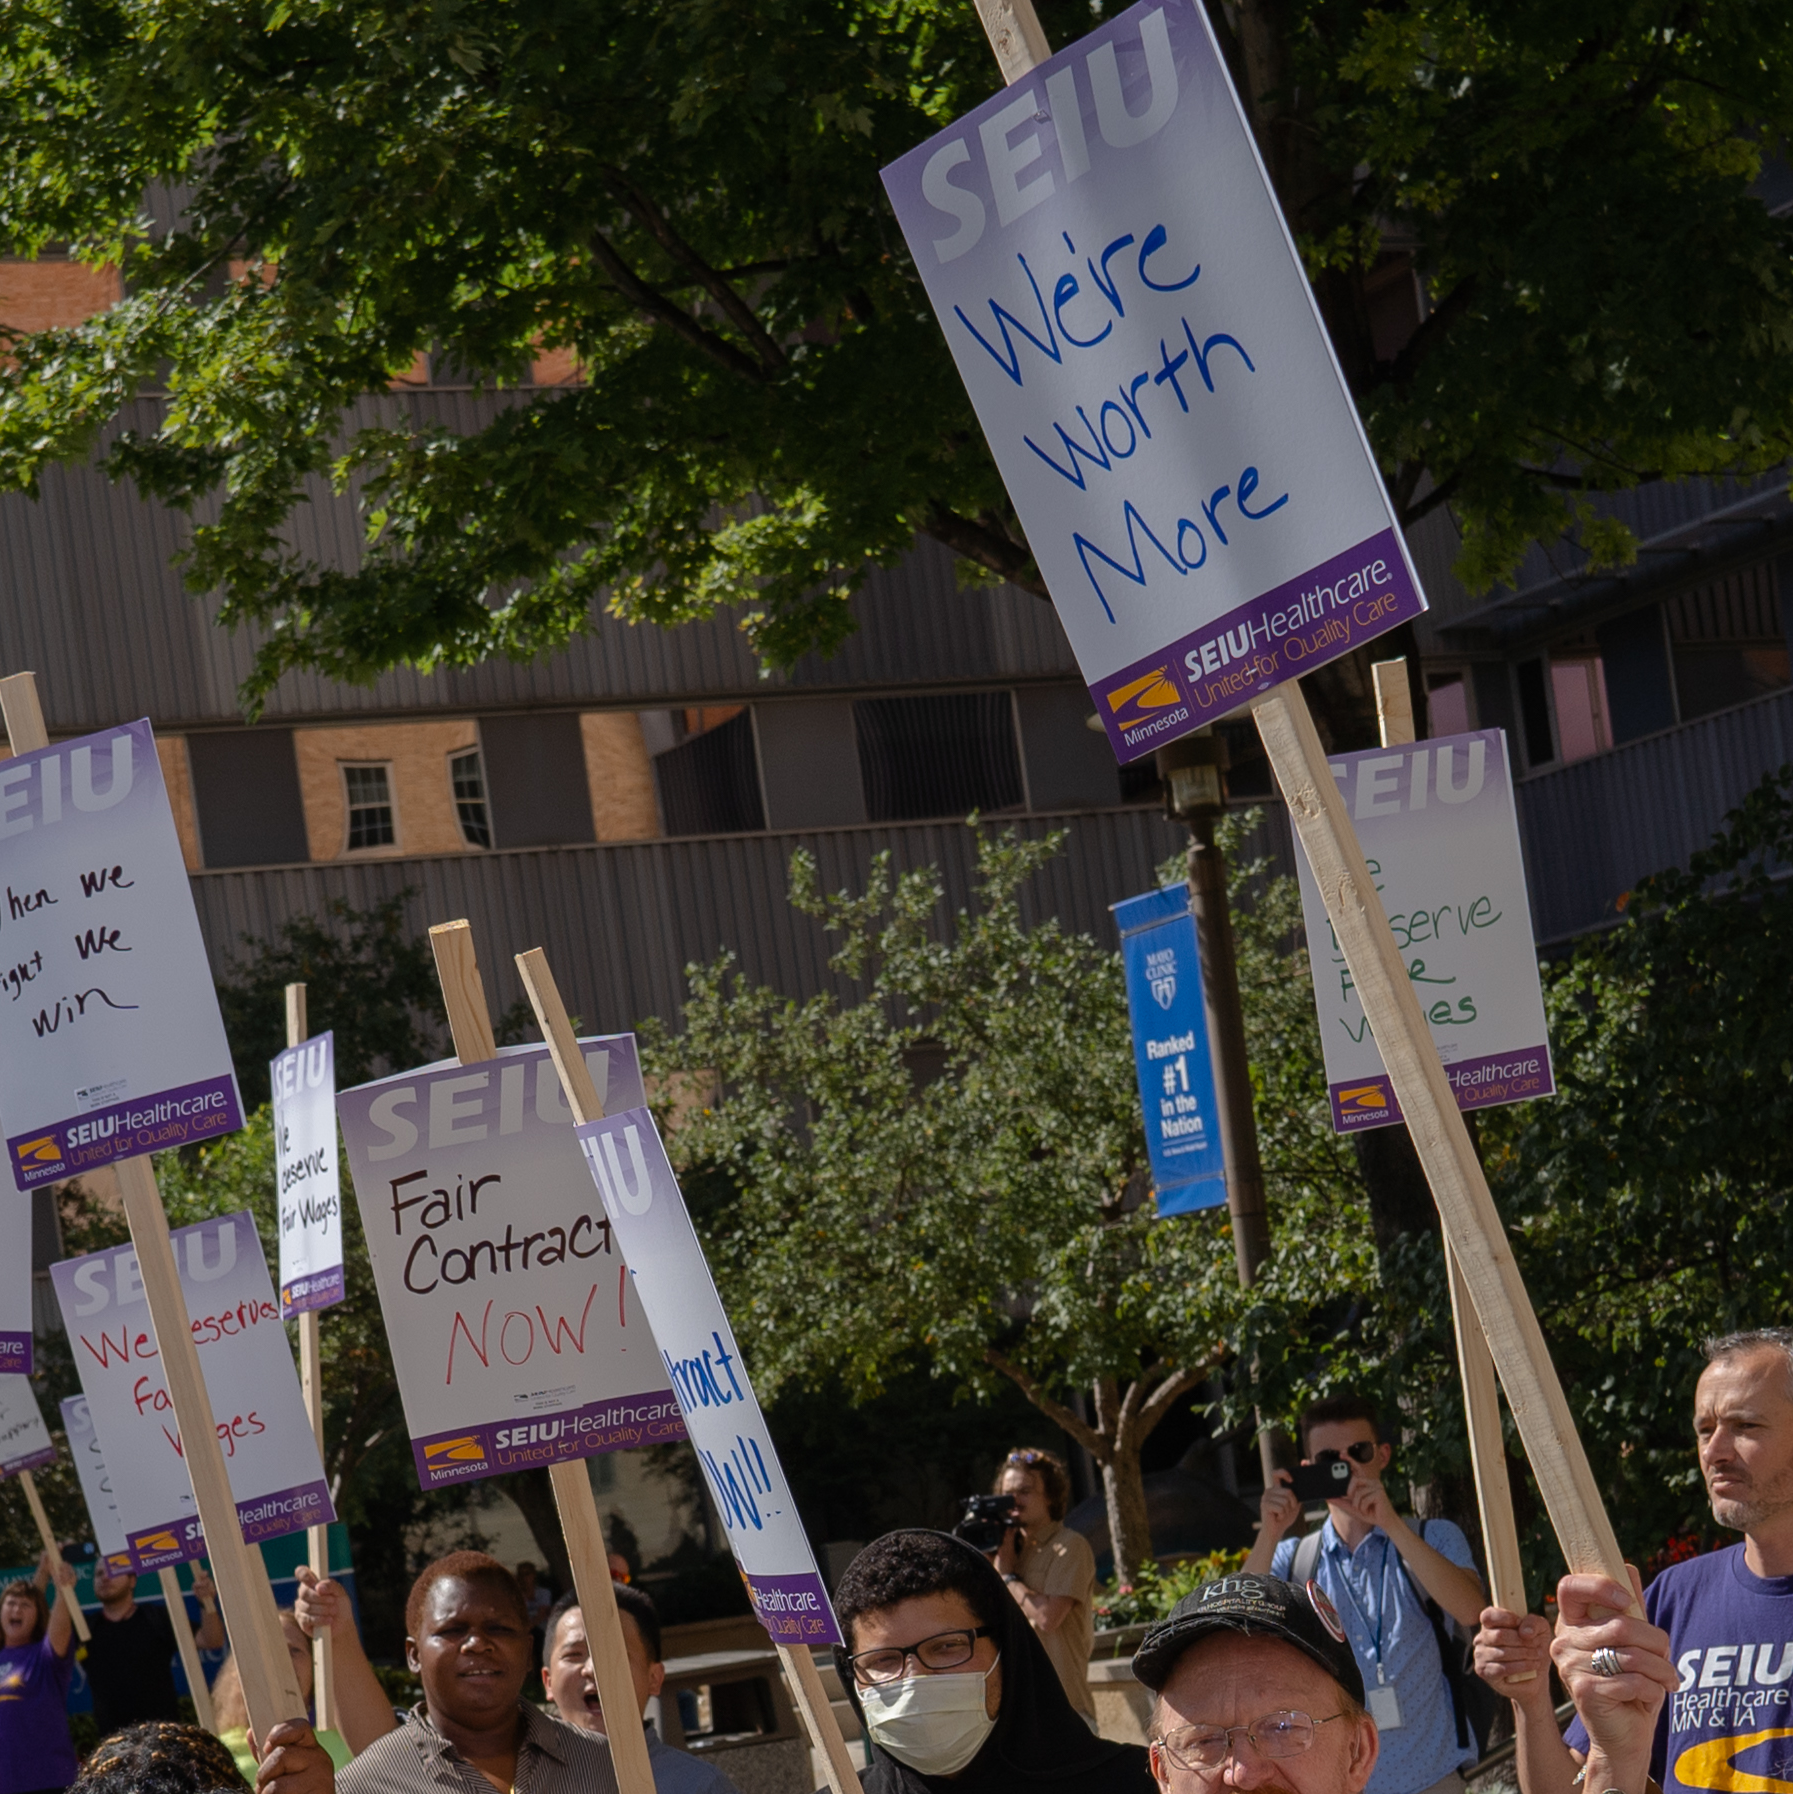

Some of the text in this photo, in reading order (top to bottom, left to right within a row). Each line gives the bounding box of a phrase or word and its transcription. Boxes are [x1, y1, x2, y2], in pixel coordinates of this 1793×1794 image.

[921, 6, 1180, 265] SEIU
[954, 223, 1201, 387] We're
[1022, 315, 1256, 491] Worth
[1072, 465, 1289, 625] More
[1184, 557, 1389, 684] SEIUHealthcare
[1193, 590, 1399, 710] United for Quality Care
[1123, 702, 1190, 747] Minnesota
[1146, 947, 1174, 966] MAYO
[1146, 961, 1177, 980] CLINIC
[1146, 1030, 1196, 1060] Ranked
[275, 1040, 327, 1107] SEIU
[1162, 1054, 1190, 1095] #1
[1464, 1077, 1539, 1103] Quality Care
[66, 1089, 224, 1148] SEIUHealthcare
[367, 1050, 609, 1162] SEIU
[1160, 1094, 1197, 1117] in the
[1160, 1116, 1203, 1139] Nation
[1342, 1109, 1389, 1125] Minnesota
[70, 1109, 227, 1167] United for Quality Care
[24, 1162, 66, 1183] Minnesota
[389, 1169, 501, 1235] Fair
[404, 1212, 612, 1295] Contract
[81, 1325, 158, 1369] We
[496, 1399, 682, 1450] SEIUHealthcare
[498, 1420, 685, 1466] United for Quality Care
[430, 1459, 489, 1482] Minnesota
[141, 1549, 183, 1569] Minnesota
[1200, 1577, 1266, 1602] khg
[1672, 1707, 1756, 1734] MN & IA
[1673, 1686, 1789, 1712] Healthcare
